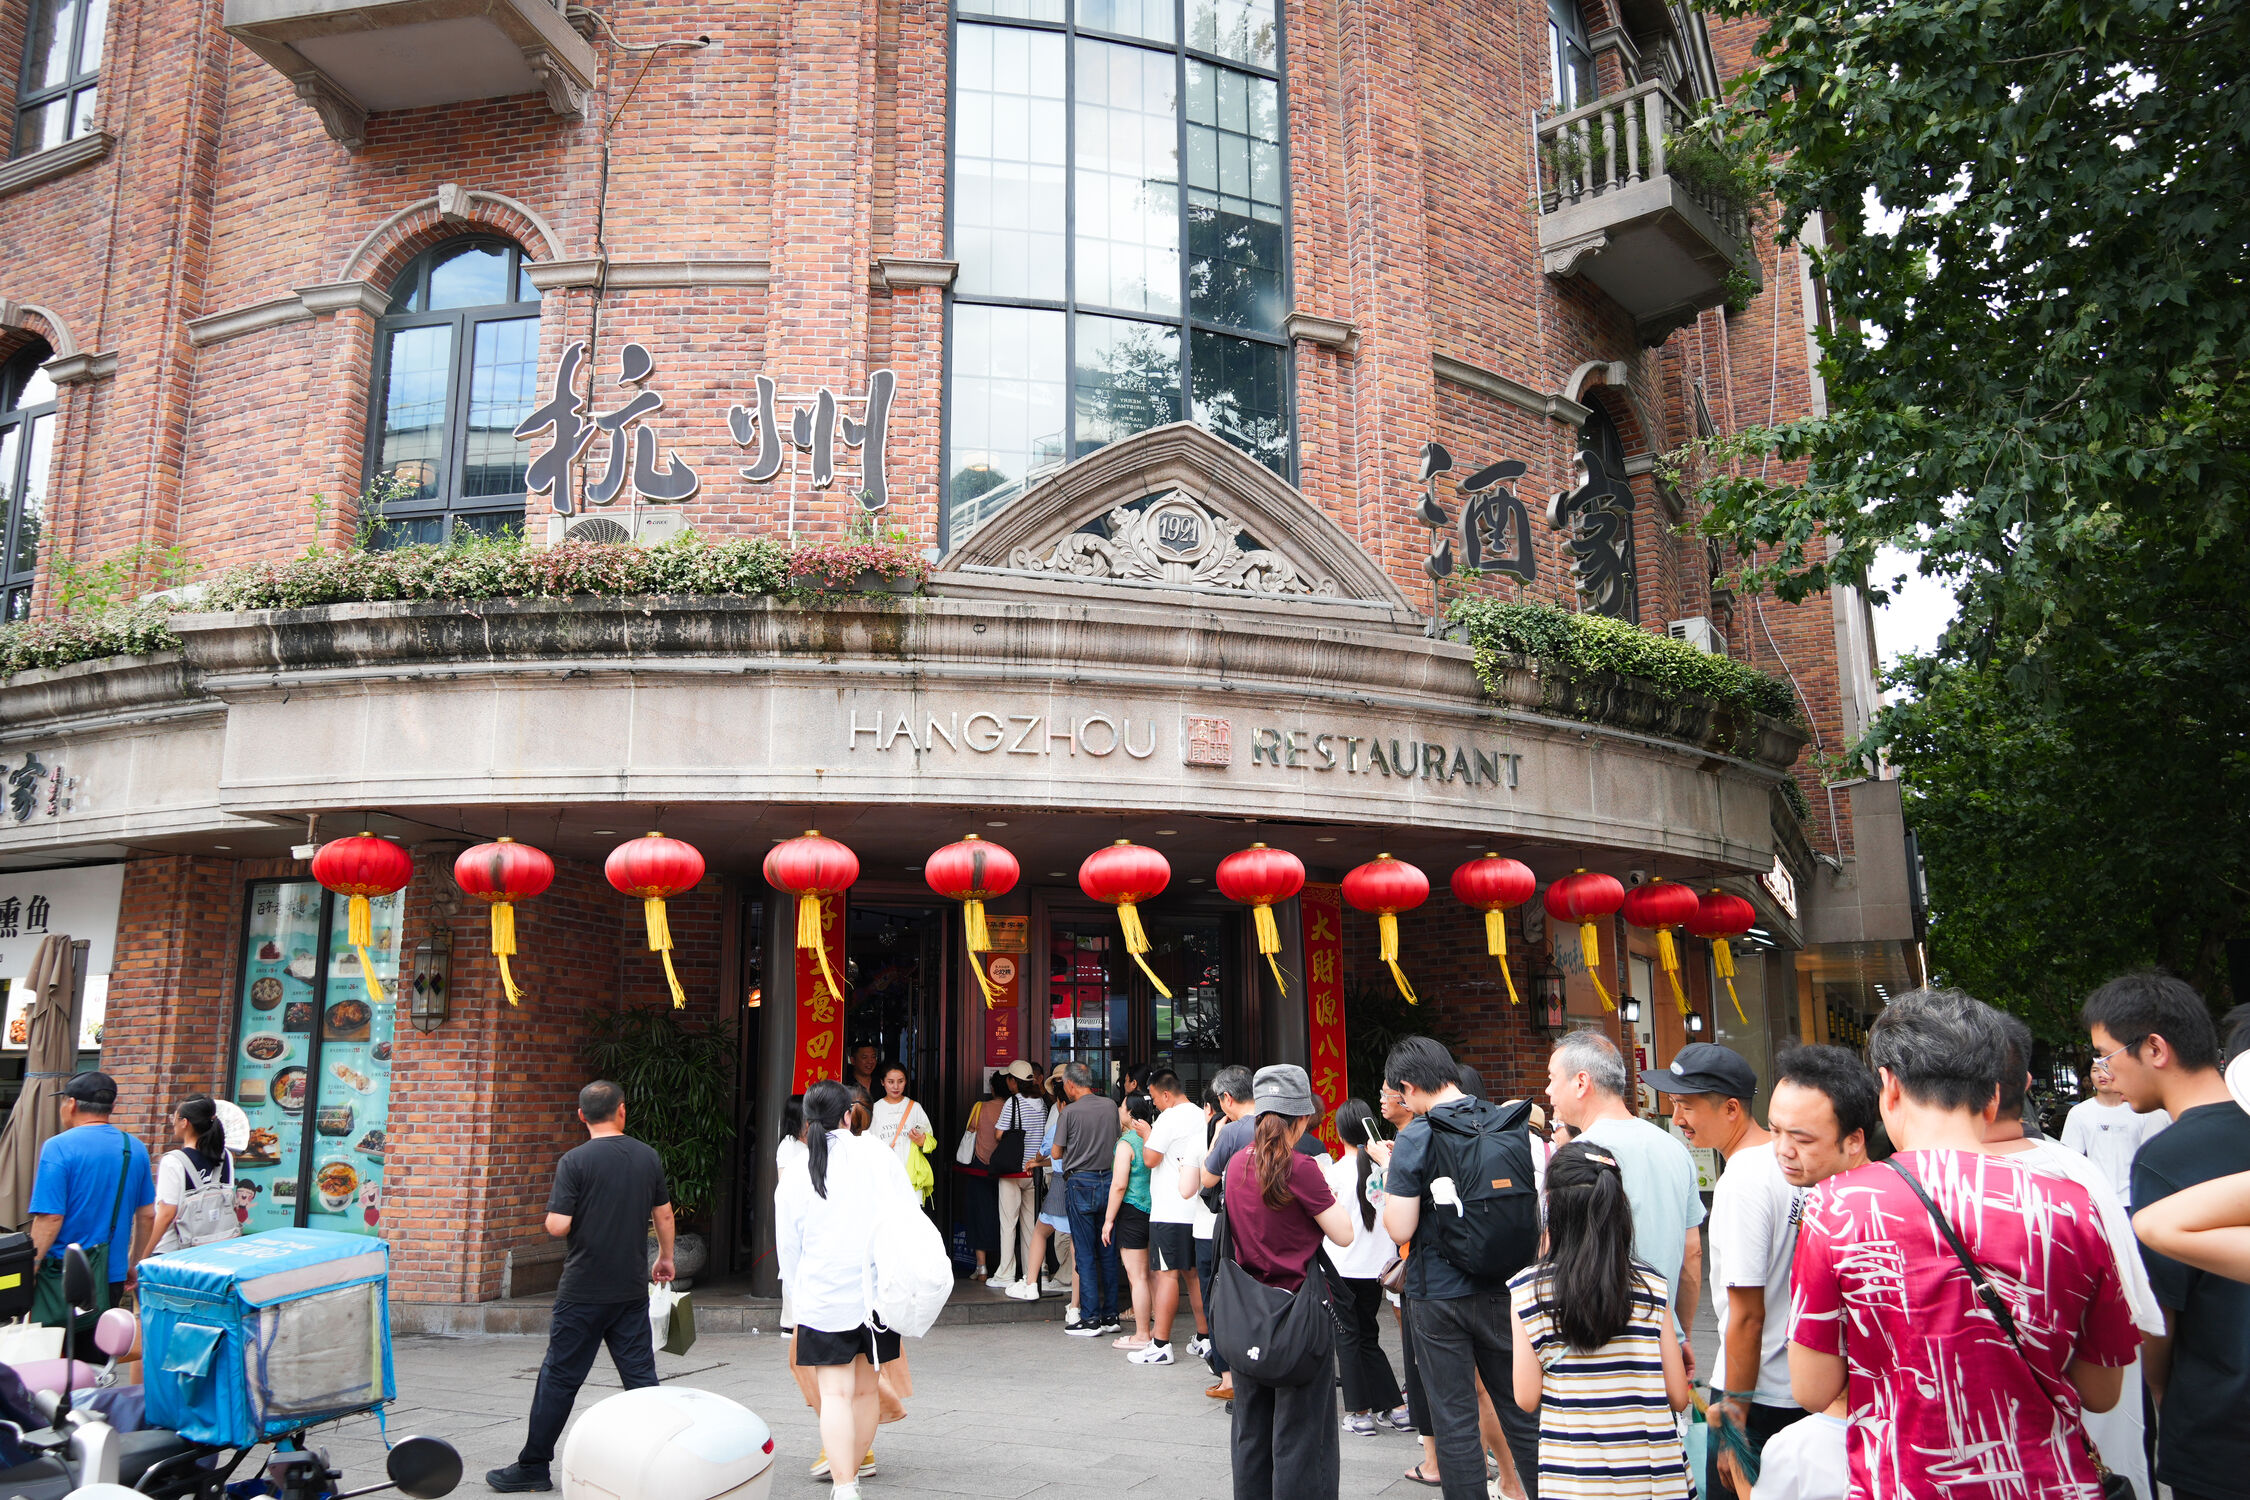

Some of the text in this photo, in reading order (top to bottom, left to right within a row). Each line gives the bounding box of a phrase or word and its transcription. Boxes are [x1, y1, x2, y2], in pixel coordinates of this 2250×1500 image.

[512, 340, 1636, 618] 杭州 酒家
[1159, 516, 1198, 542] 1921
[0, 752, 48, 822] 家
[849, 709, 1524, 788] HANGZHOU RESTAURANT
[1311, 909, 1340, 1163] 大財源八方涌
